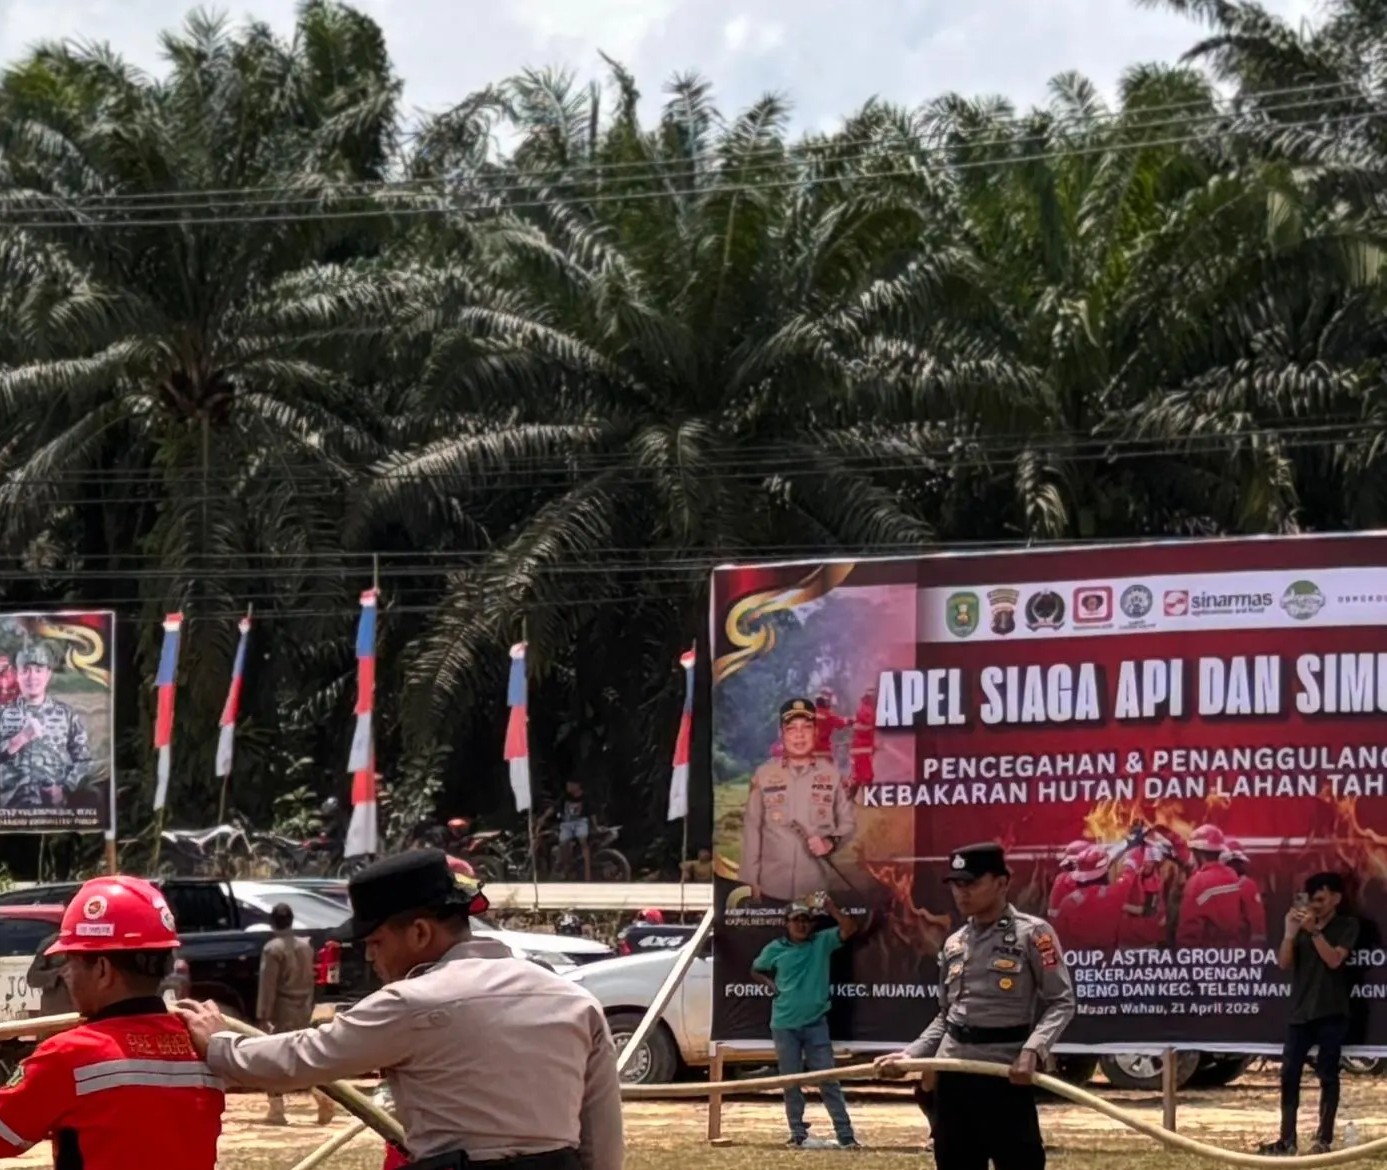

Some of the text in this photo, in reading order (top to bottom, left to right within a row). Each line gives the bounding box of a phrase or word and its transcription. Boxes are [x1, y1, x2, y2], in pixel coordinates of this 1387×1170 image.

[1191, 592, 1272, 609] sinarmas
[875, 668, 967, 728] APEL
[979, 662, 1100, 725] SIAGA
[1115, 657, 1183, 719] API
[1198, 654, 1280, 716] DAN
[923, 752, 1116, 780] PENCEGAHAN
[1125, 751, 1143, 774] &
[863, 781, 1027, 807] KEBAKARAN
[1038, 777, 1134, 804] HUTAN
[1144, 776, 1204, 800] DAN
[1215, 774, 1317, 798] LAHAN
[1111, 949, 1173, 966] ASTRA
[1176, 948, 1246, 966] GROUP
[1249, 949, 1279, 966] DA
[1074, 966, 1262, 983] BEKERJASAMA DENGAN
[837, 983, 870, 997] KEC.
[872, 984, 925, 998] MUARA
[1076, 983, 1120, 998] BENG
[1122, 982, 1156, 997] DAN
[1158, 982, 1194, 997] KEC.
[1198, 981, 1251, 997] TELEN
[1077, 1002, 1260, 1017] Muara Wahau, 21 April 2026
